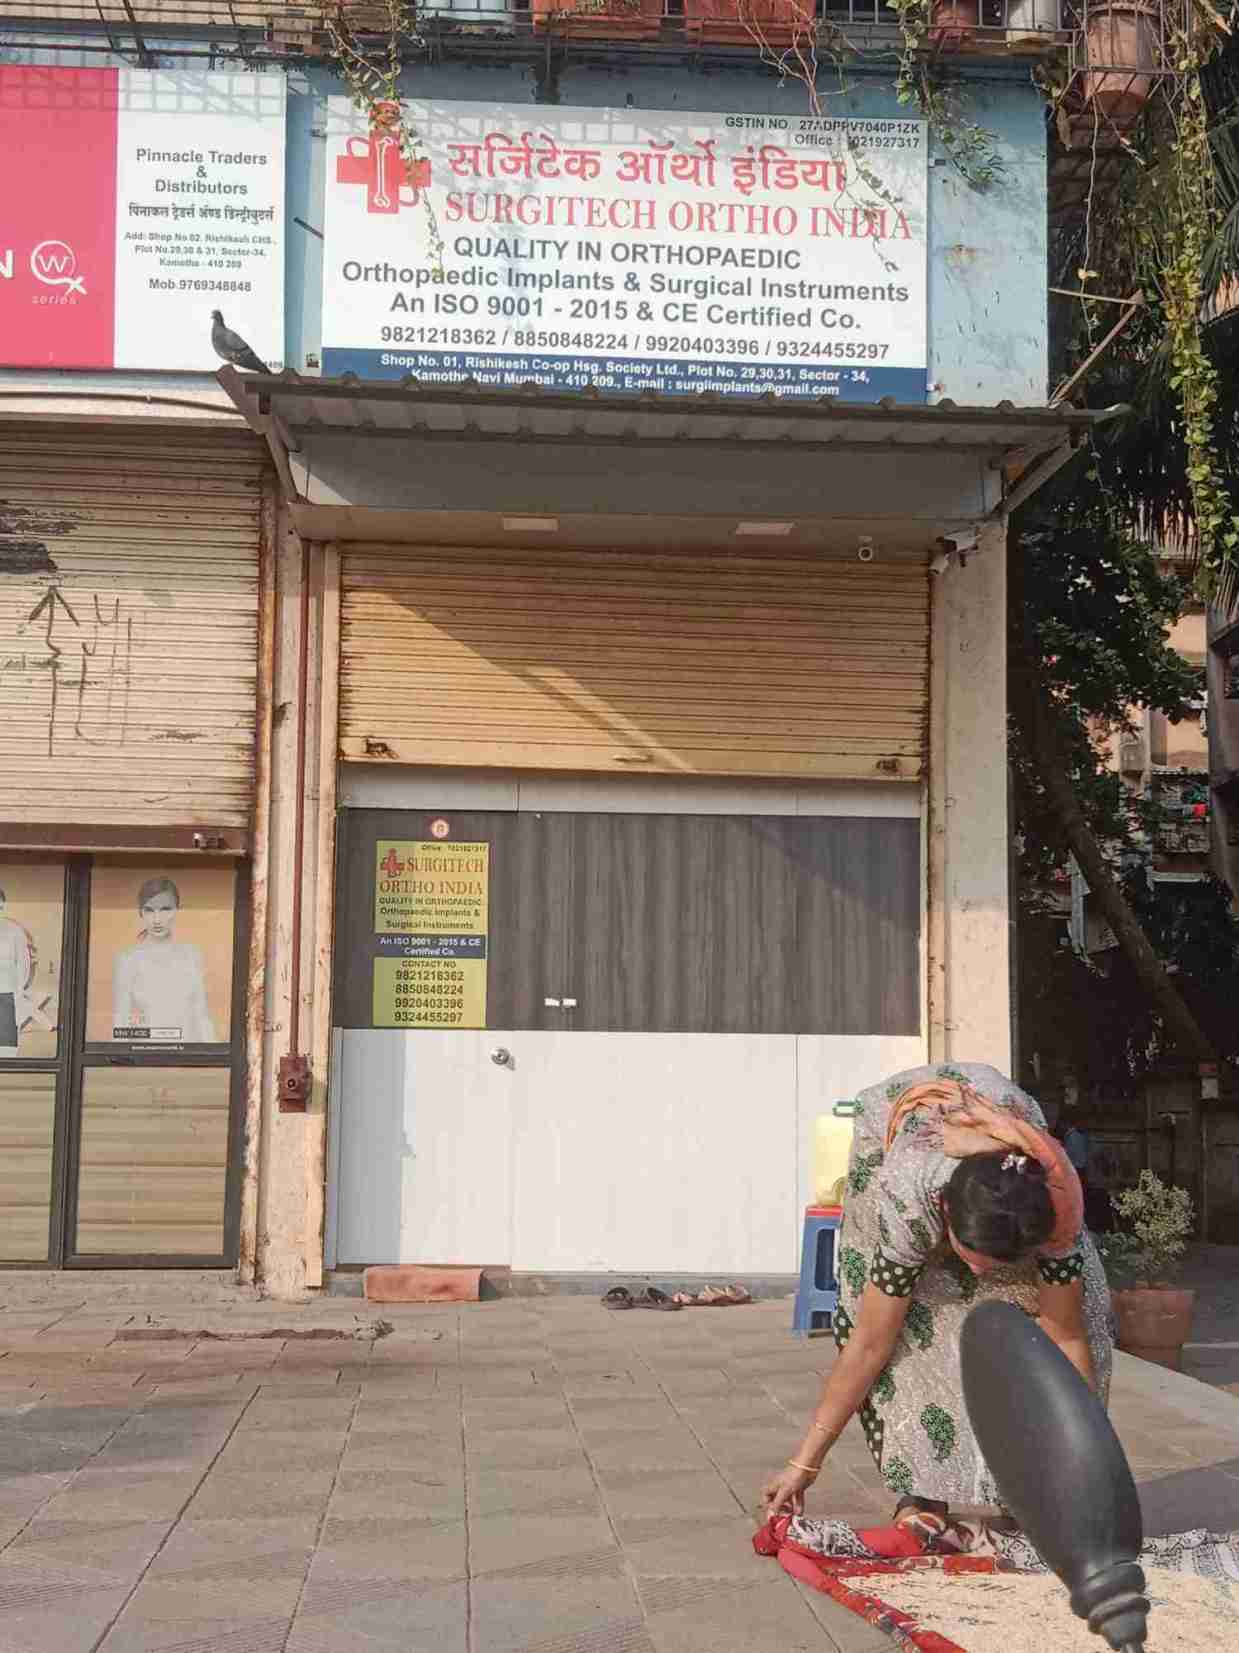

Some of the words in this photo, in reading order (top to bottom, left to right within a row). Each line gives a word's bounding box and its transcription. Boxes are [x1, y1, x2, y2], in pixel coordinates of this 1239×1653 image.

[725, 116, 765, 129] GSTIN
[794, 133, 833, 146] Office
[136, 148, 204, 163] Pinnacle
[208, 150, 268, 165] Traders
[447, 131, 601, 181] सर्जिटेक
[615, 138, 718, 188] ऑर्थो
[731, 144, 847, 197] इंडिया
[196, 165, 208, 178] &
[155, 178, 249, 196] Distributors
[445, 191, 656, 233] SURGITECH
[668, 200, 798, 237] ORTHO
[811, 205, 912, 241] INDIA
[454, 236, 568, 259] QUALITY
[577, 240, 602, 261] IN
[611, 242, 801, 269] ORTHOPAEDIC
[342, 261, 498, 288] Orthopaedic
[508, 266, 614, 293] Implants
[623, 272, 641, 293] &
[650, 273, 752, 300] Surgical
[761, 278, 909, 303] Instruments
[390, 292, 425, 313] An
[434, 294, 479, 316] ISO
[487, 296, 544, 317] 9001
[569, 299, 628, 321] 2015
[636, 302, 654, 321] &
[663, 303, 698, 323] CE
[706, 304, 812, 328] Certified
[820, 308, 861, 330] Co.
[381, 326, 496, 346] 9821218362
[502, 329, 508, 346] /
[514, 330, 628, 350] 8850848224
[634, 335, 640, 351] /
[646, 335, 759, 357] 9920403396
[765, 339, 771, 357] /
[776, 339, 889, 361] 9324455297
[380, 354, 415, 371] Shop
[418, 356, 440, 368] No.
[465, 357, 529, 371] Rishikesh
[532, 359, 570, 374] Co-op
[574, 360, 602, 375] Hsg.
[606, 361, 653, 378] Society
[688, 365, 714, 378] Plot
[716, 366, 737, 379] No.
[800, 368, 840, 382] Sector
[503, 372, 554, 385] Mumbai
[565, 374, 588, 386] 410
[624, 376, 664, 390] E-mail
[407, 856, 484, 873] SURGITECH
[380, 879, 433, 895] ORTHO
[440, 880, 483, 896] INDIA
[401, 960, 441, 968] CONTACT
[394, 998, 465, 1010] 9920403396
[394, 1011, 465, 1023] 9324455297
